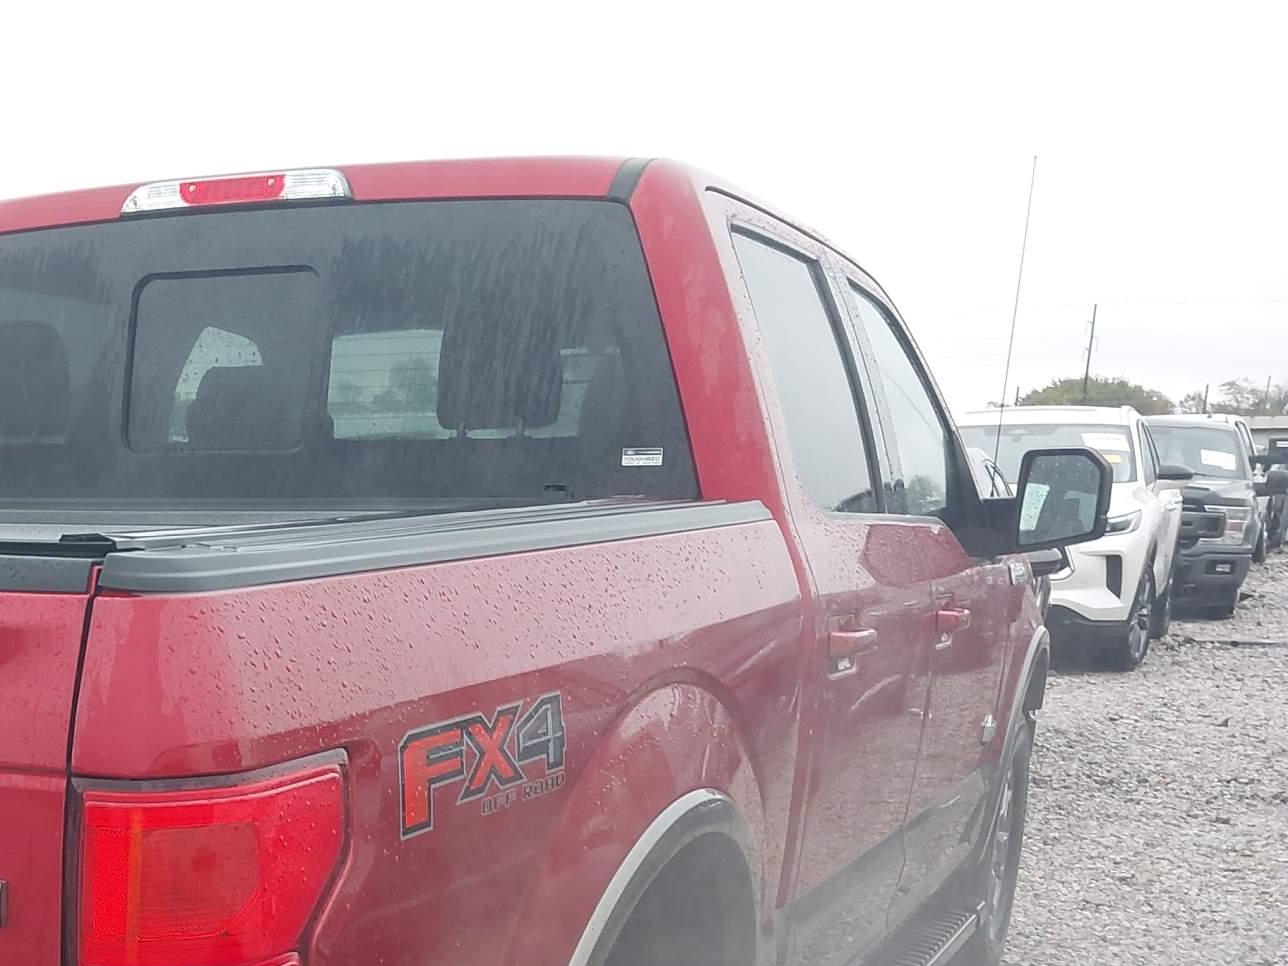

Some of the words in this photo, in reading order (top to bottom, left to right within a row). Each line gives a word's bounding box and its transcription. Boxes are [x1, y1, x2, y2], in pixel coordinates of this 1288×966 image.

[398, 691, 566, 841] FX4
[481, 788, 517, 816] OFF
[521, 771, 566, 801] ROAD
